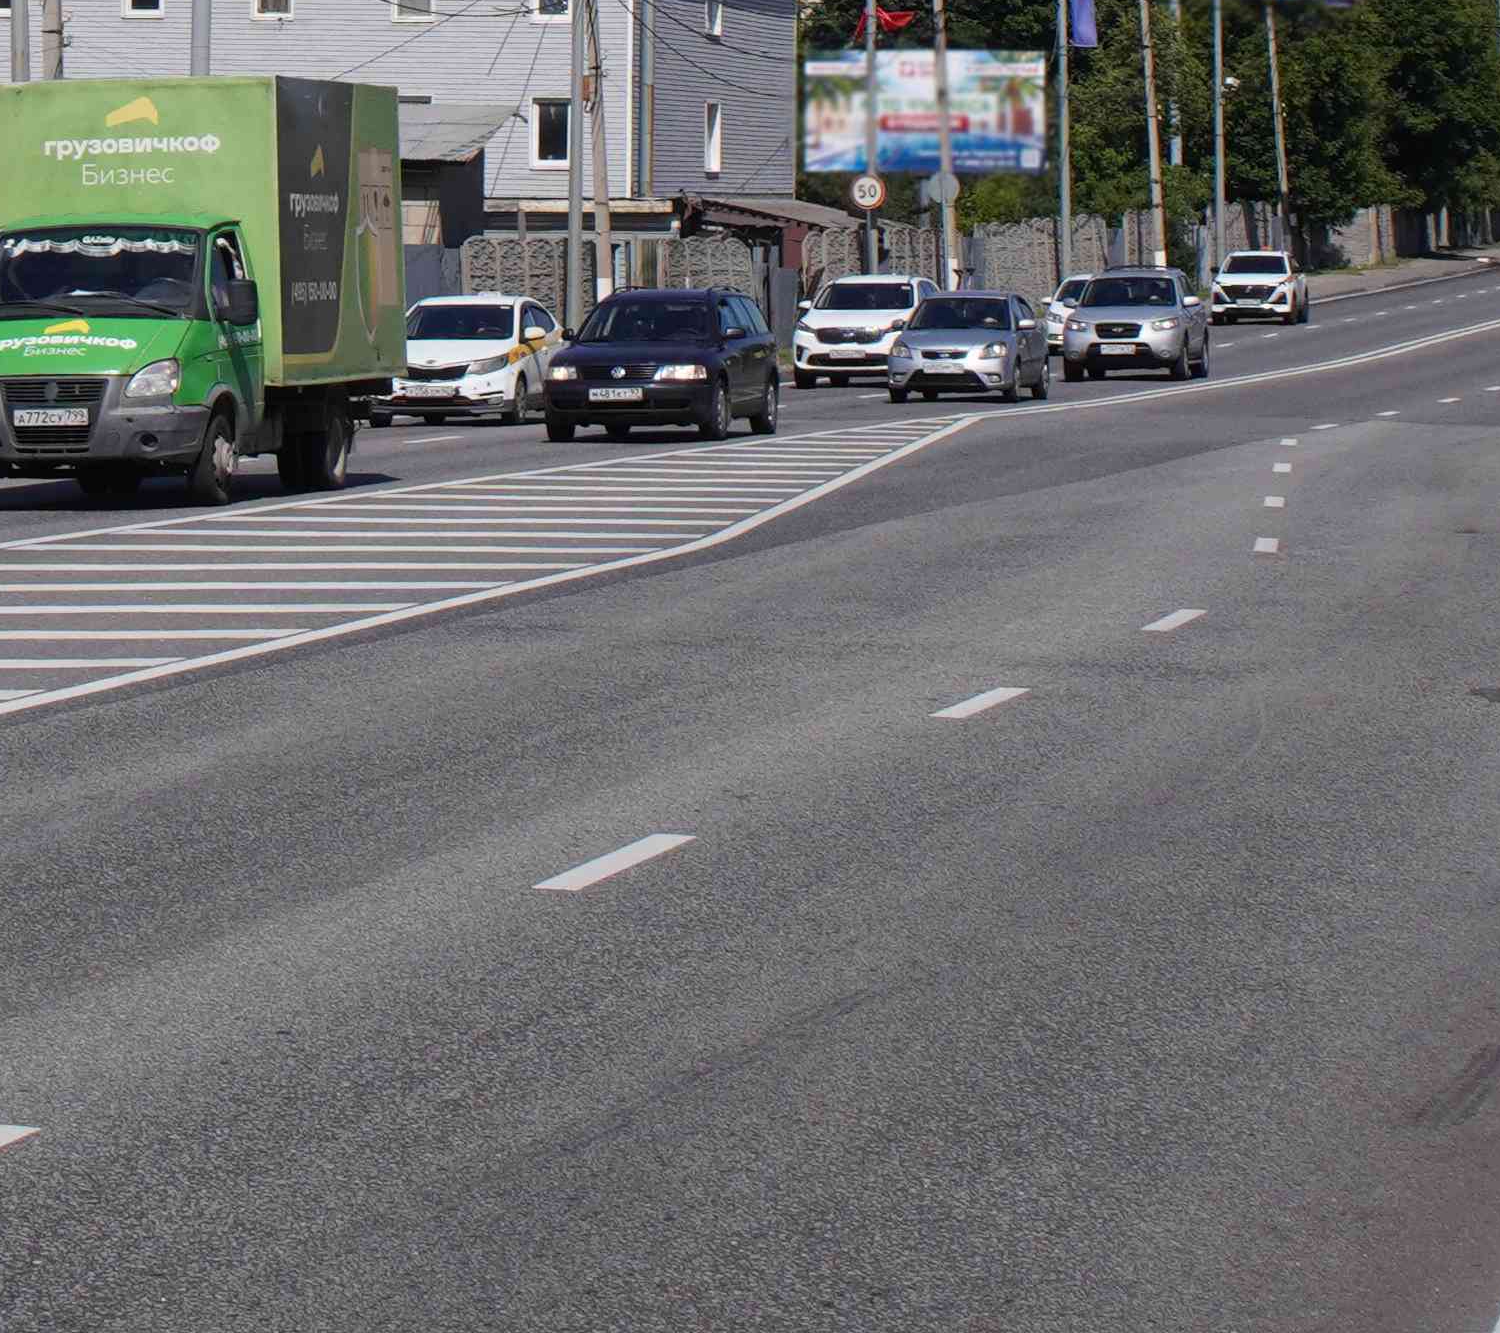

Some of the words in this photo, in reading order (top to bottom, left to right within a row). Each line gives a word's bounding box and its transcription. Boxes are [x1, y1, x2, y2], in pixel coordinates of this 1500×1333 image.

[43, 133, 221, 160] грузовичкоф
[81, 163, 176, 185] Бизнес
[858, 183, 877, 199] 50
[23, 346, 87, 357] Бизнес
